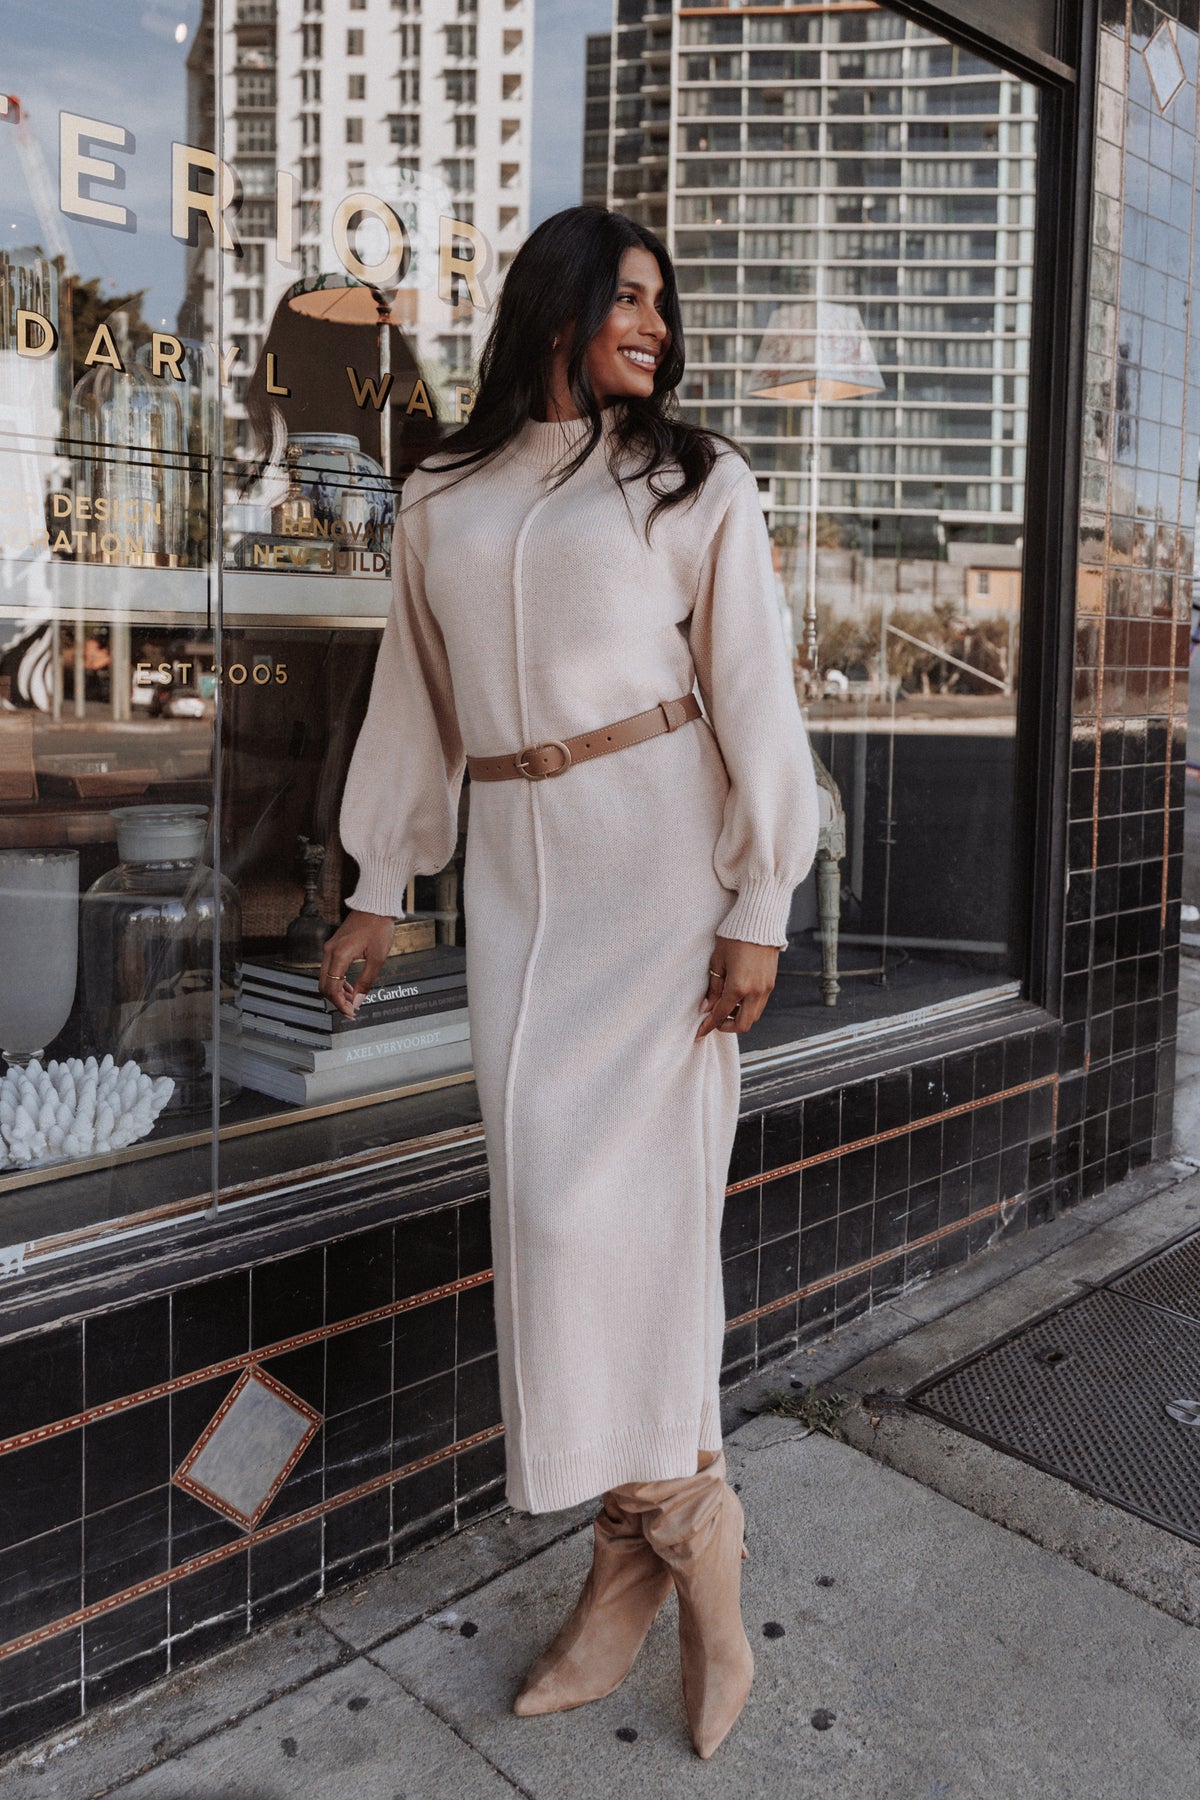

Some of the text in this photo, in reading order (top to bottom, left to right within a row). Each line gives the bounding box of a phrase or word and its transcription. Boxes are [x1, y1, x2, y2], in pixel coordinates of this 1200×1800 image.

[0, 94, 495, 312] ERIOR
[16, 309, 291, 397] DARYL
[53, 494, 161, 525] DESIGN
[253, 543, 388, 573] NEW BUILD
[136, 663, 288, 686] EST 2005
[377, 985, 419, 1001] Gardens
[346, 1031, 441, 1061] AXEL VERVOORDT
